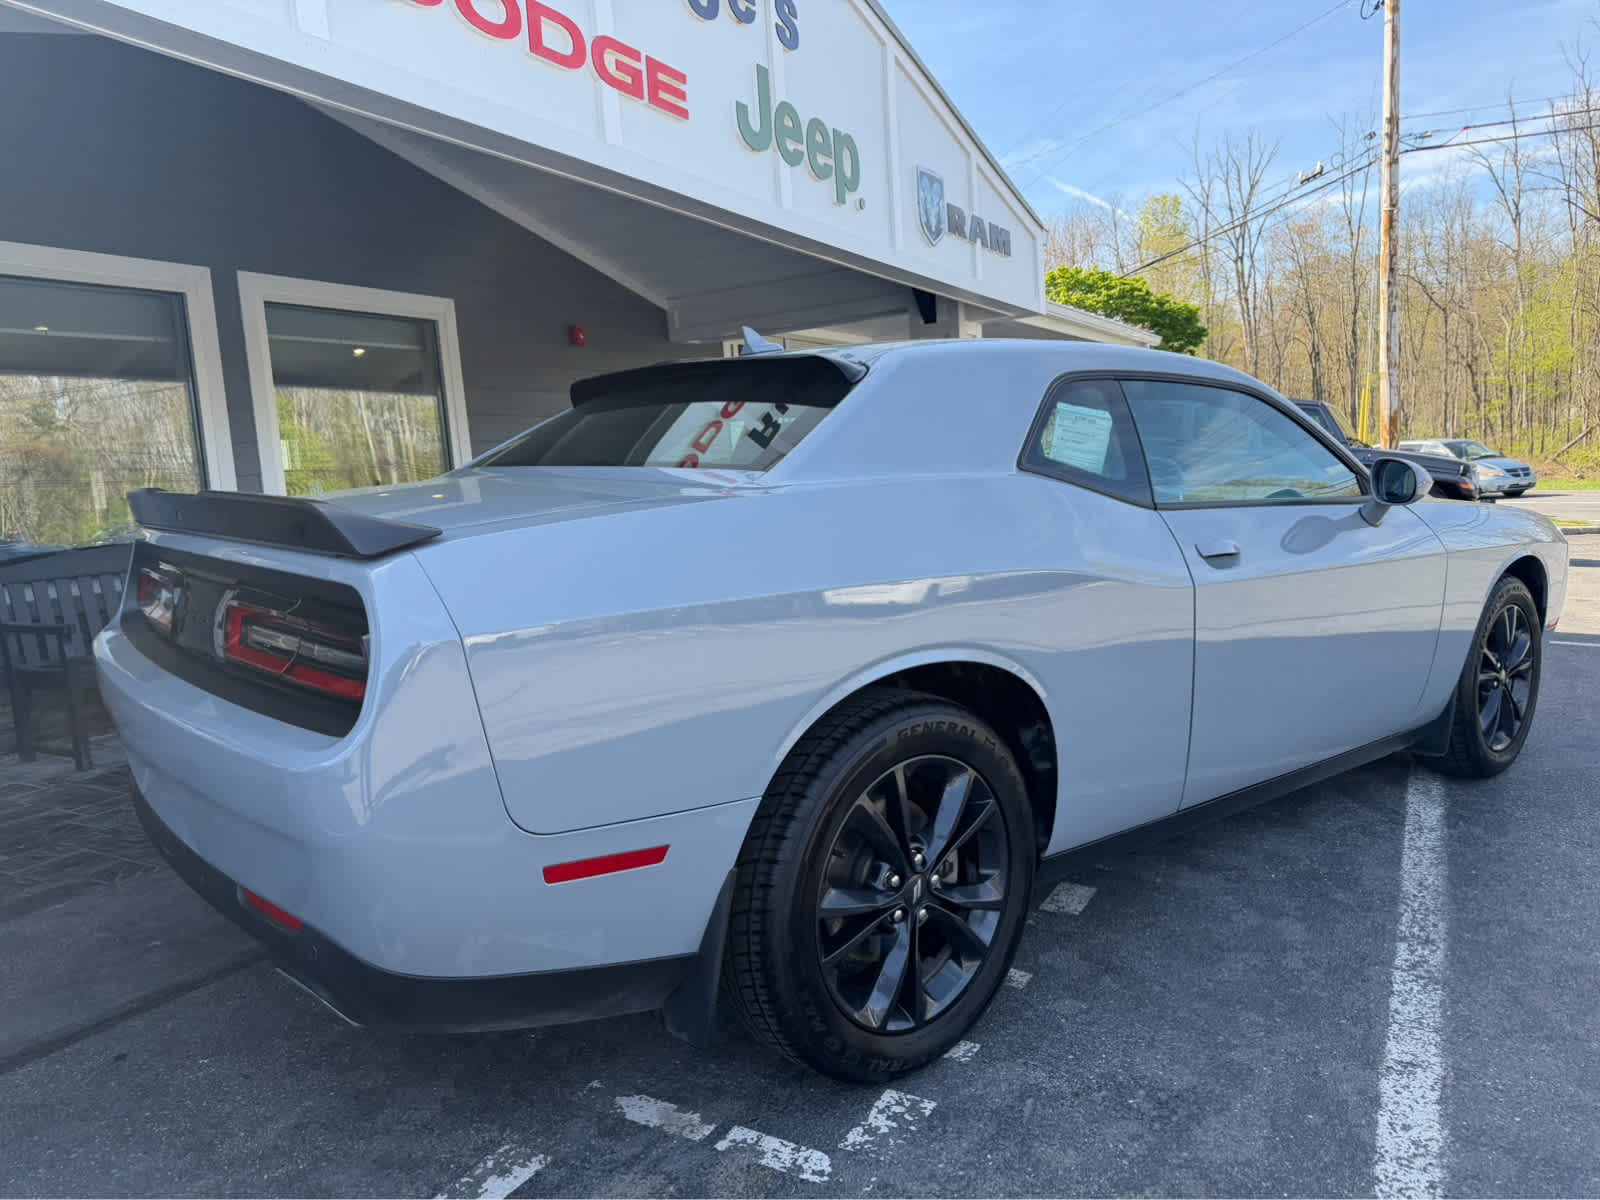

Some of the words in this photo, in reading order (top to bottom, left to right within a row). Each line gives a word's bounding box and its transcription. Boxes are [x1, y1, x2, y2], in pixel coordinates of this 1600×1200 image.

[409, 0, 690, 121] ODGE
[946, 202, 1011, 257] RAM
[897, 719, 977, 739] GENERAL
